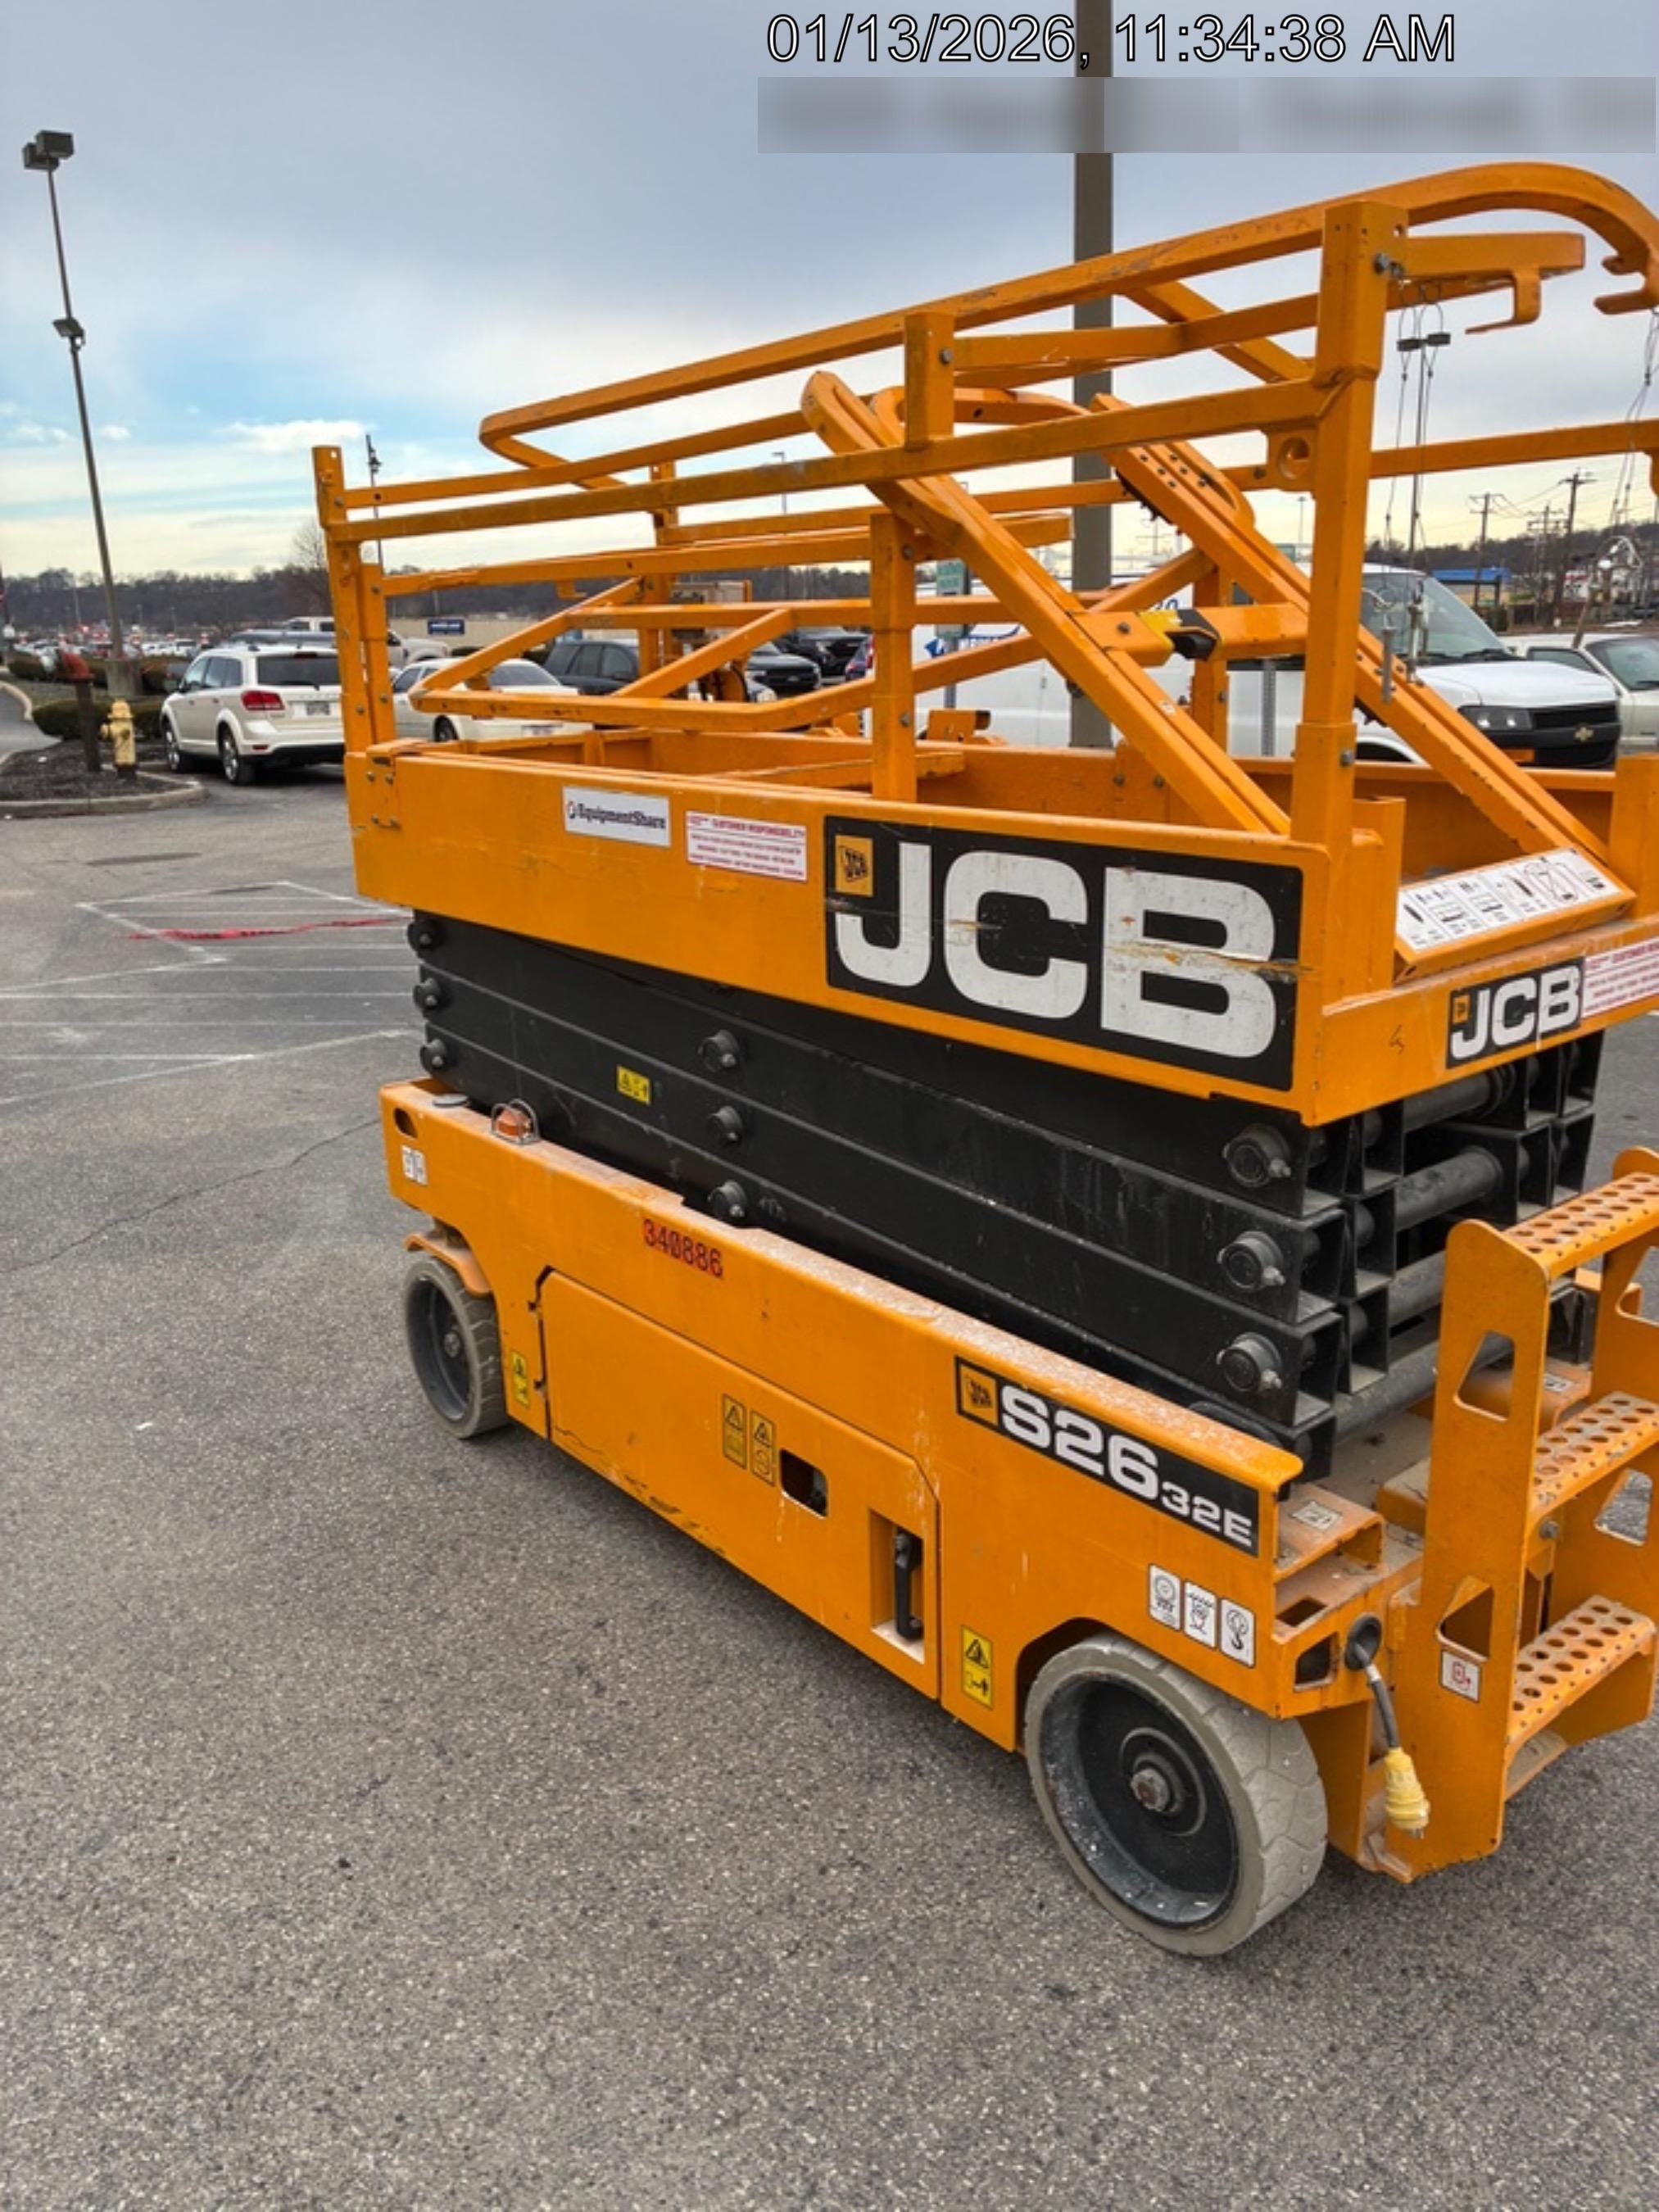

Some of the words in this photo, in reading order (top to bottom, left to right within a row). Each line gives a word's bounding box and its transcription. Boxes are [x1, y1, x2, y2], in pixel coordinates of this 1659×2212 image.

[577, 802, 666, 829] EquipmentShare
[835, 842, 1276, 1058] JCB
[1450, 965, 1581, 1059] JCB
[643, 1218, 724, 1278] 340886
[1002, 1385, 1158, 1500] S26
[1160, 1481, 1253, 1547] 32E
